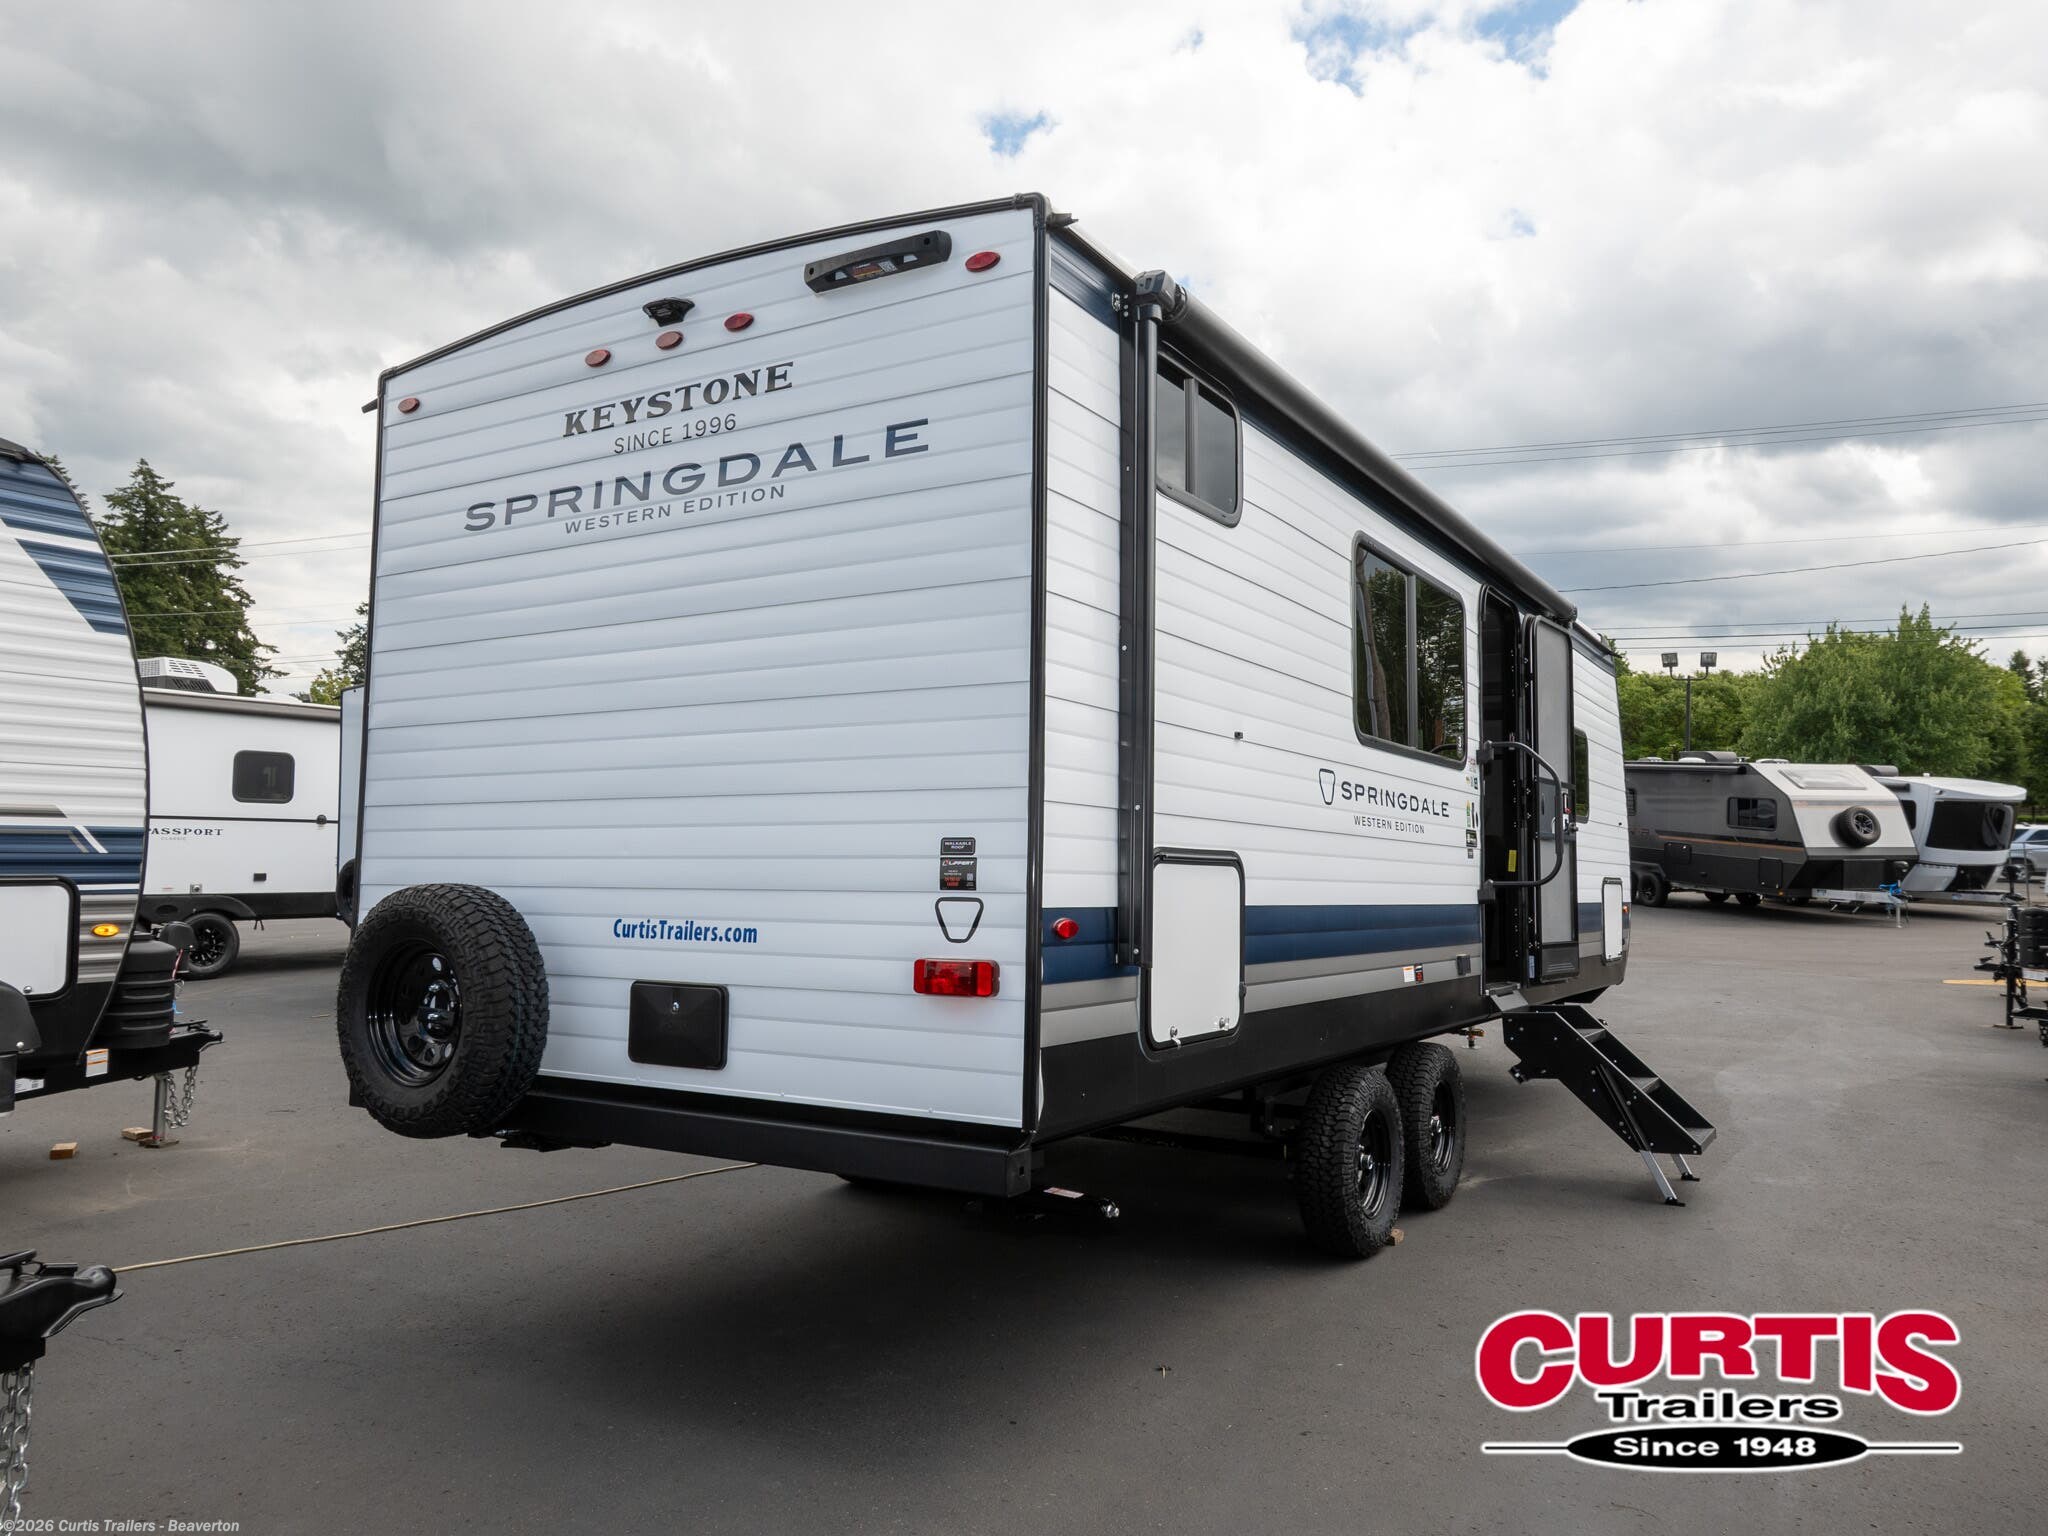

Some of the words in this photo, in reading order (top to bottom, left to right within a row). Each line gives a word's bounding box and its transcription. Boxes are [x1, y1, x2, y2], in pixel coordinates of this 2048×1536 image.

[562, 361, 794, 438] KEYSTONE
[613, 426, 673, 454] SINCE
[682, 412, 737, 440] 1996
[463, 418, 930, 532] SPRINGDALE
[564, 503, 672, 534] WESTERN
[683, 484, 786, 514] EDITION
[1340, 781, 1450, 818] SPRINGDALE
[1353, 815, 1393, 830] WESTERN
[1395, 821, 1425, 834] EDITION
[613, 918, 758, 943] CurtisTrailers.com
